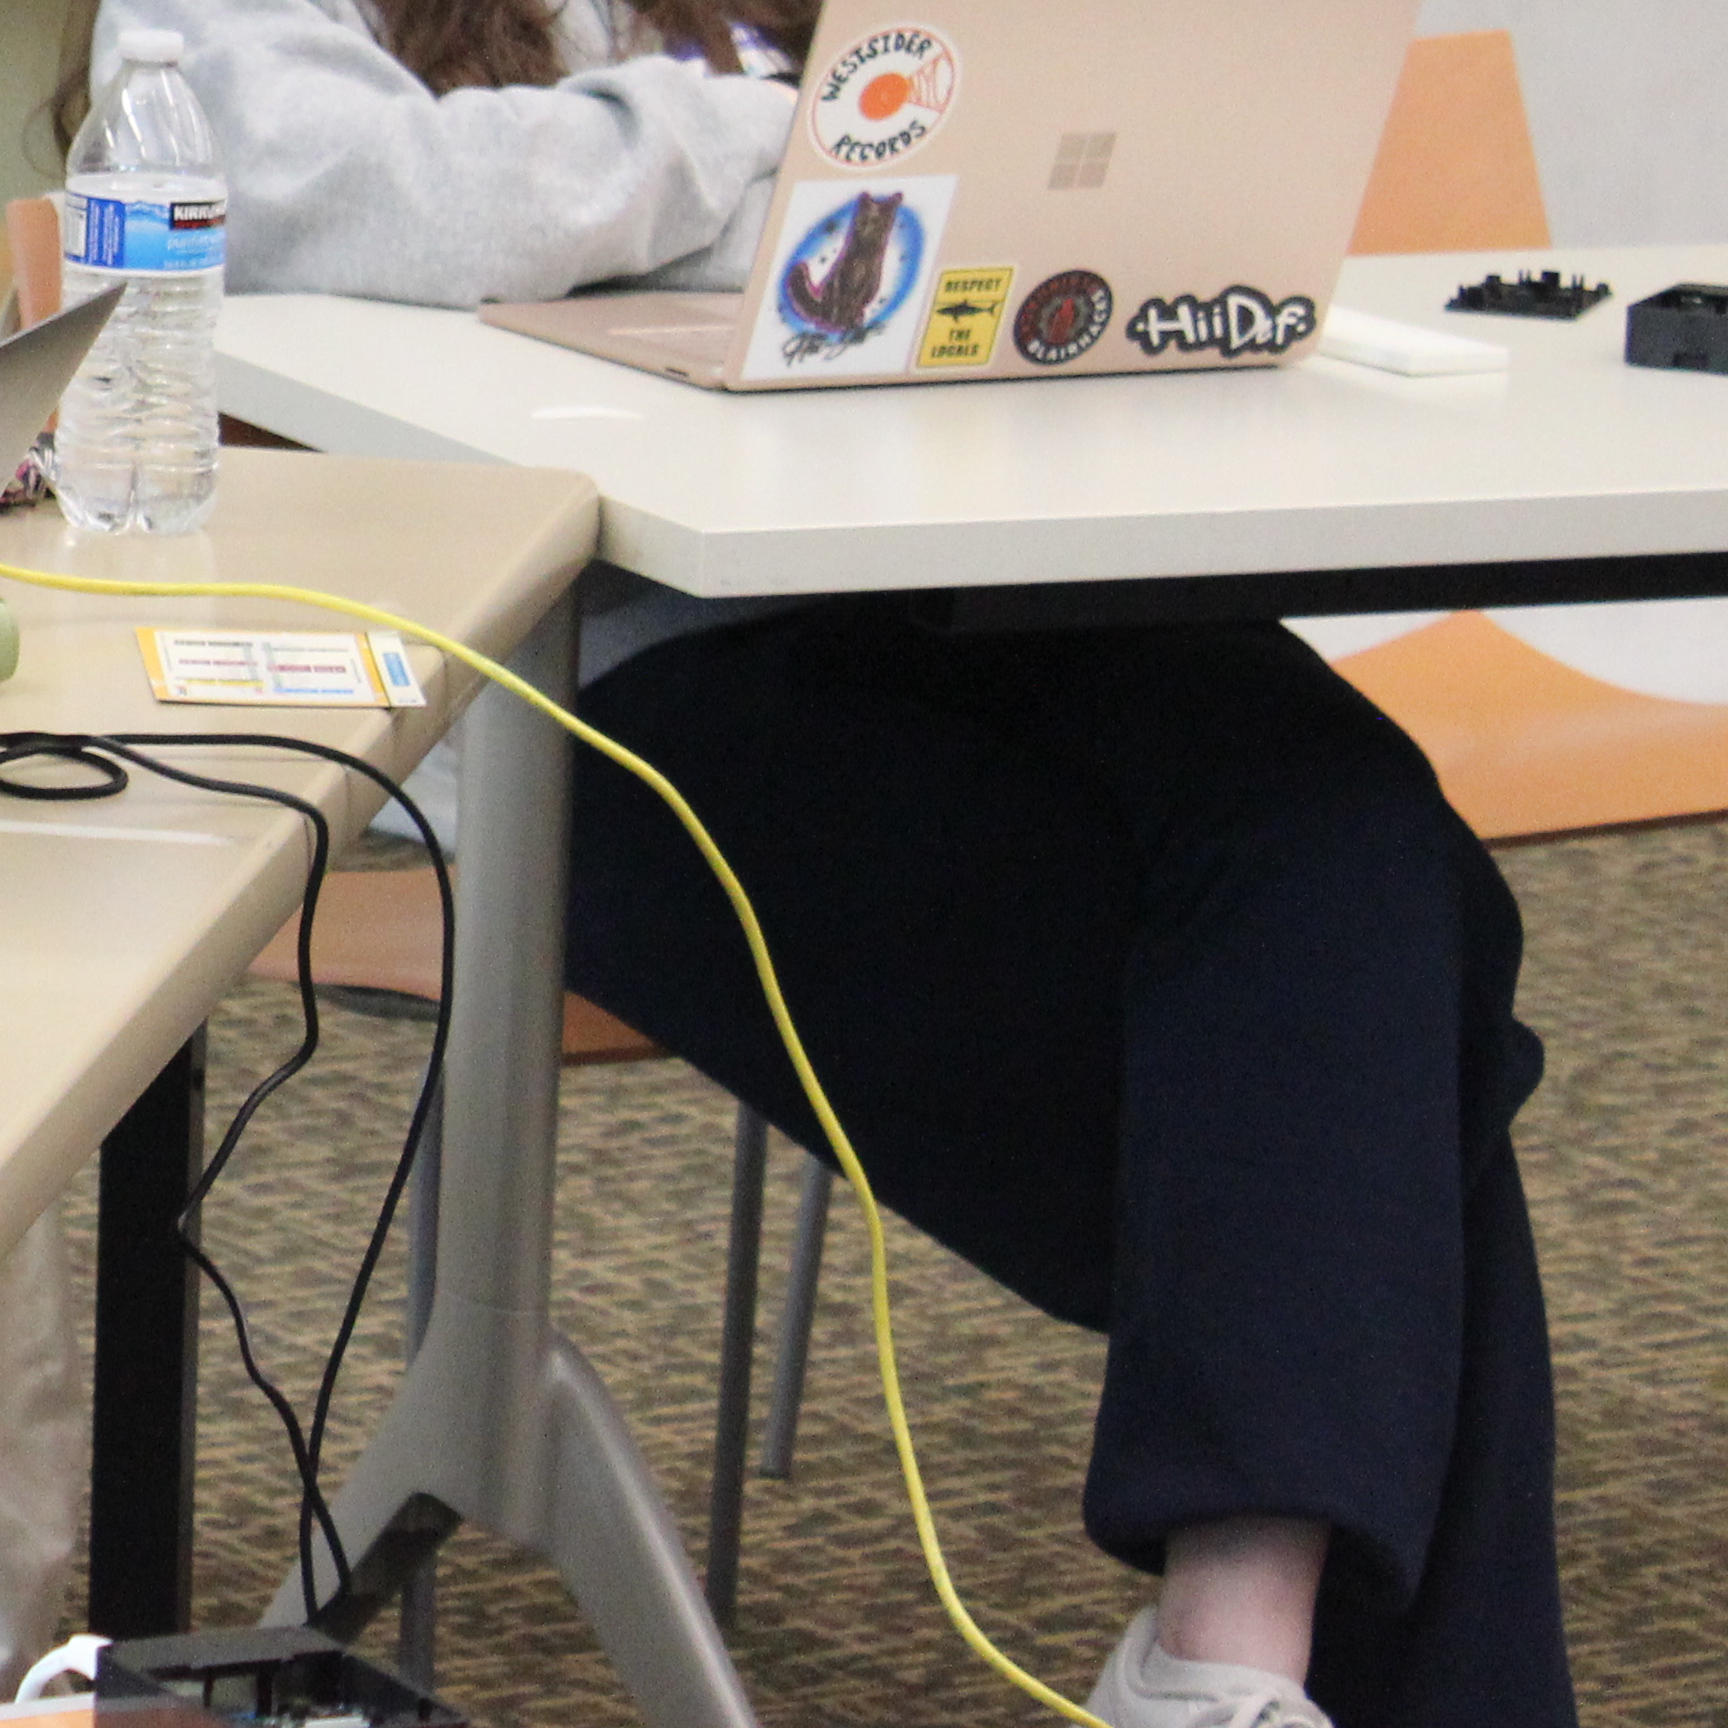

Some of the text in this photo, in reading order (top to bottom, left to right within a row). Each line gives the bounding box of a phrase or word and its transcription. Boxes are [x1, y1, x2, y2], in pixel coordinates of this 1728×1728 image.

[821, 32, 931, 102] WESTSIDER
[831, 121, 927, 161] RECORDS
[945, 279, 1002, 292] RESPECT
[949, 329, 971, 341] THE
